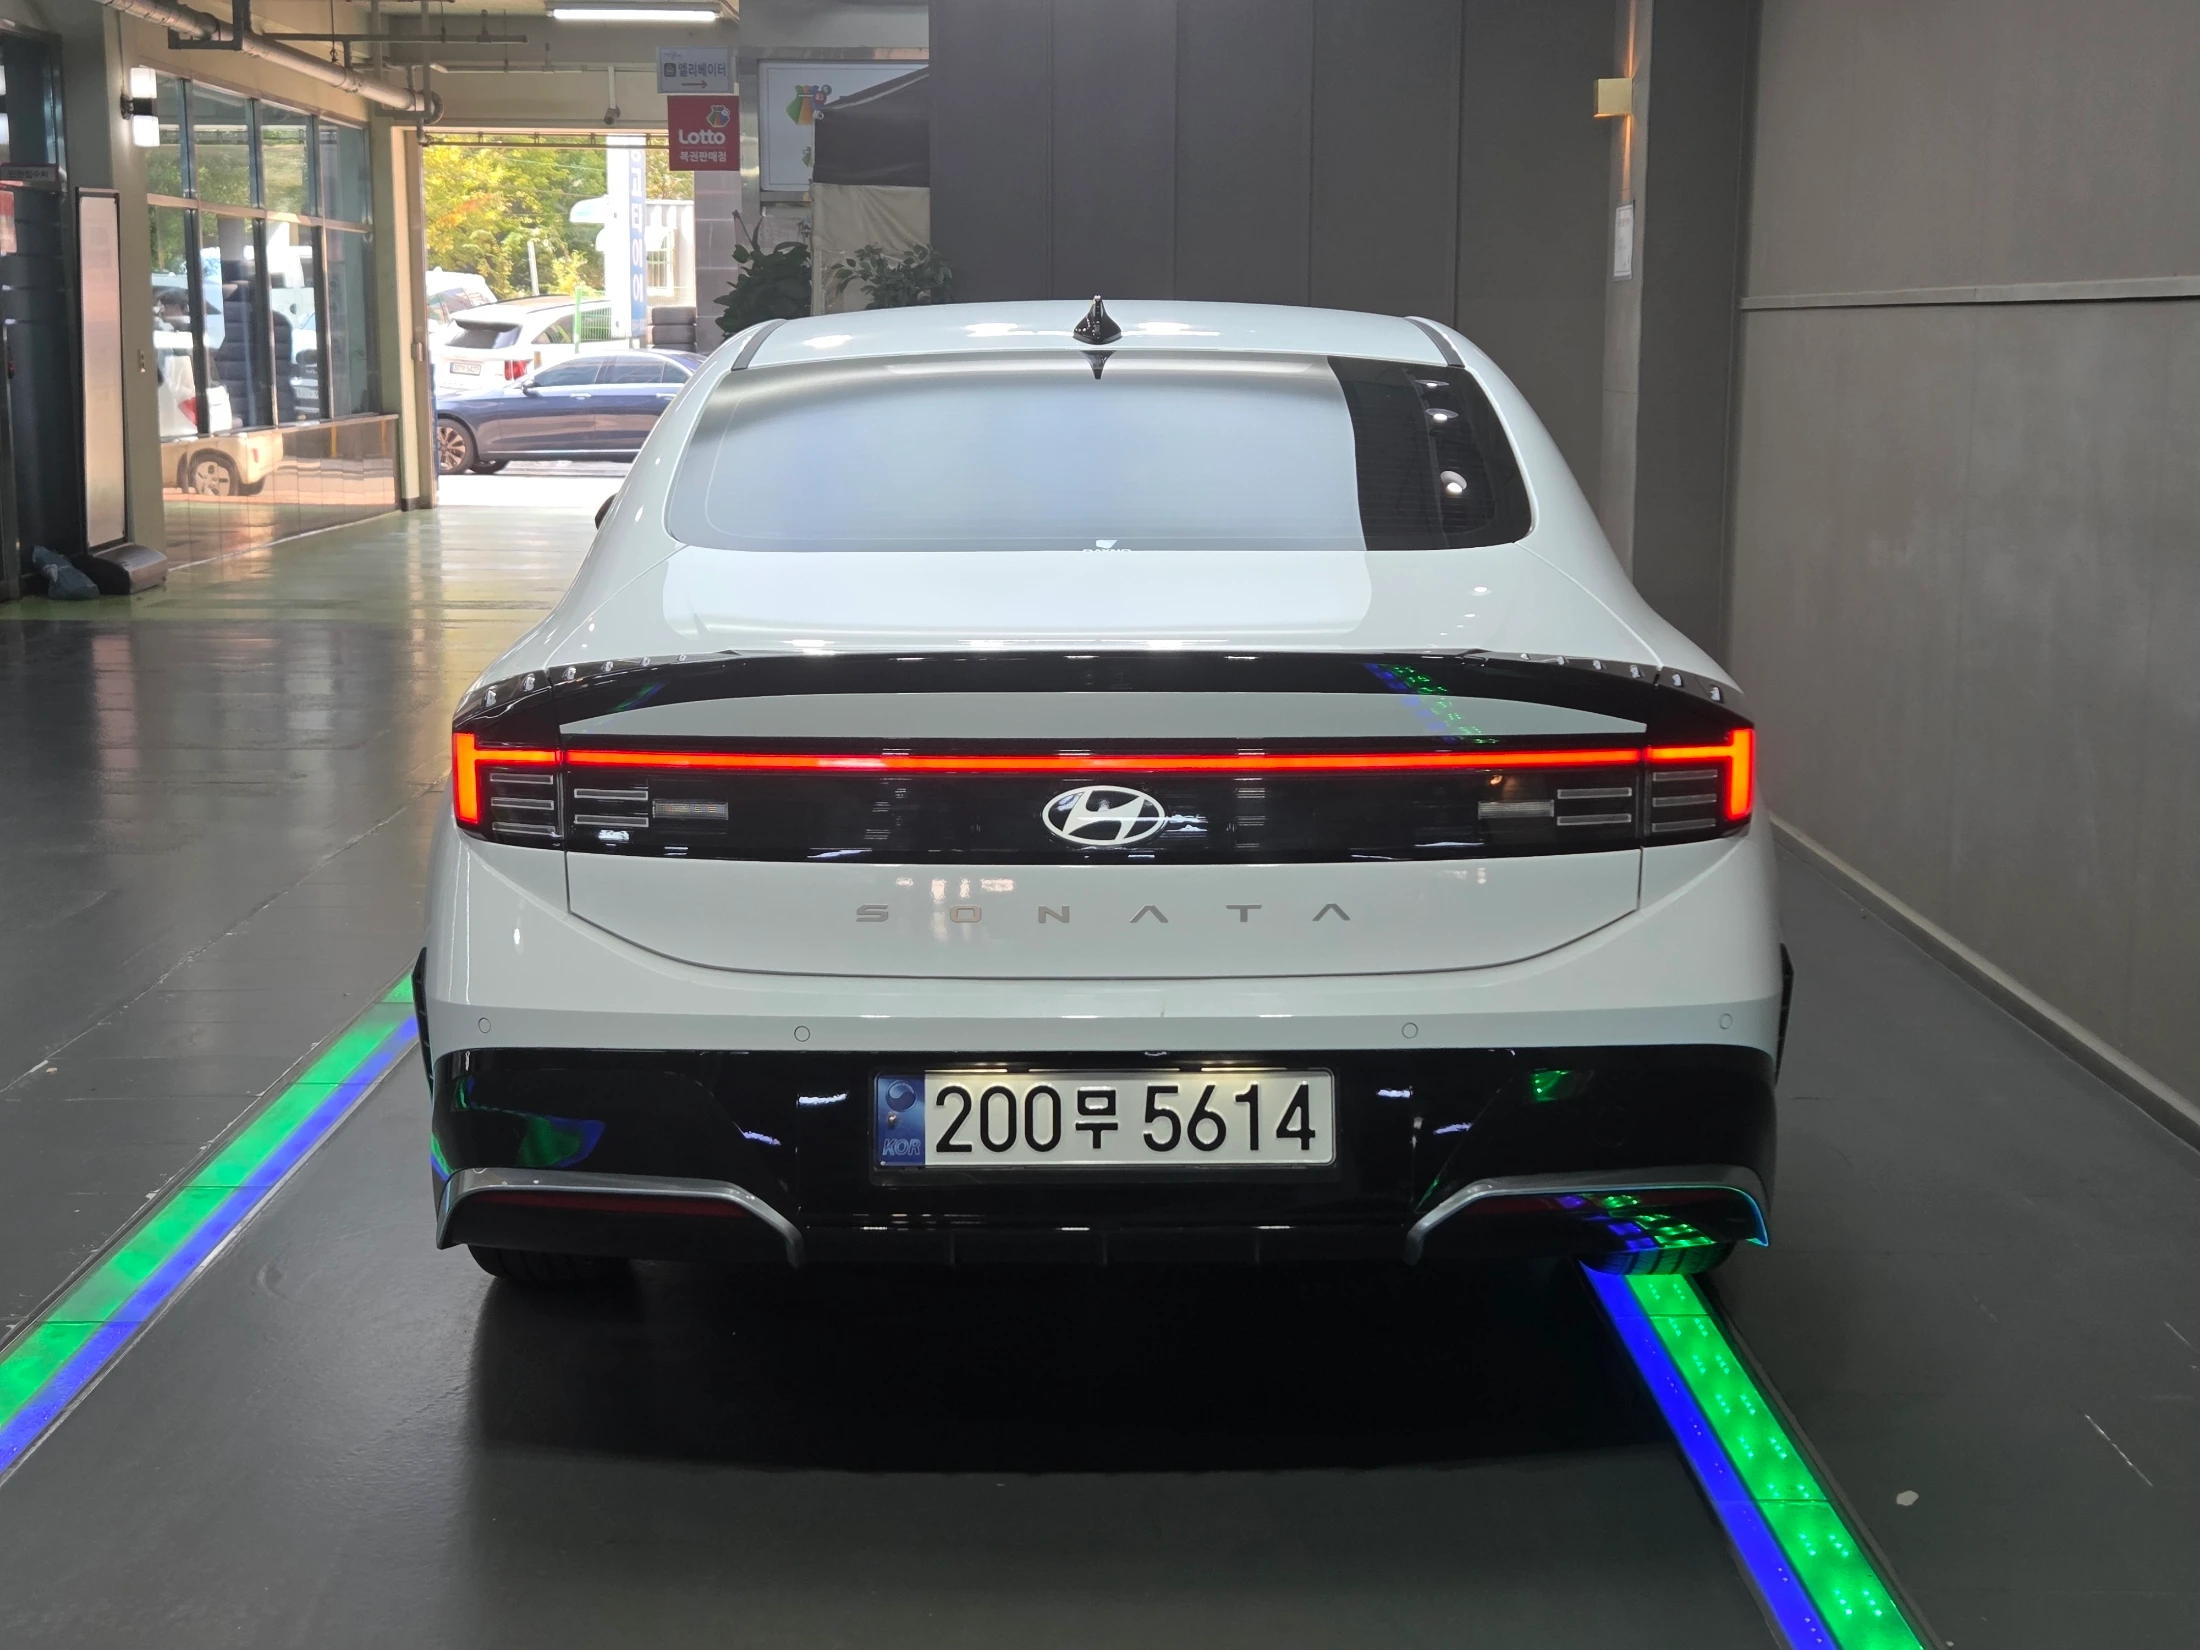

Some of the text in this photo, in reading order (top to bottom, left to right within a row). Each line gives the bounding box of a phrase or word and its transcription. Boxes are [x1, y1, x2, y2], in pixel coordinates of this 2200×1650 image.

[678, 62, 727, 77] 엘리베이터
[678, 129, 726, 145] Lotto
[679, 151, 727, 163] 복권판매점
[855, 903, 1352, 924] SONATA
[935, 1082, 1318, 1154] 200무 5614
[882, 1138, 922, 1156] KOR
